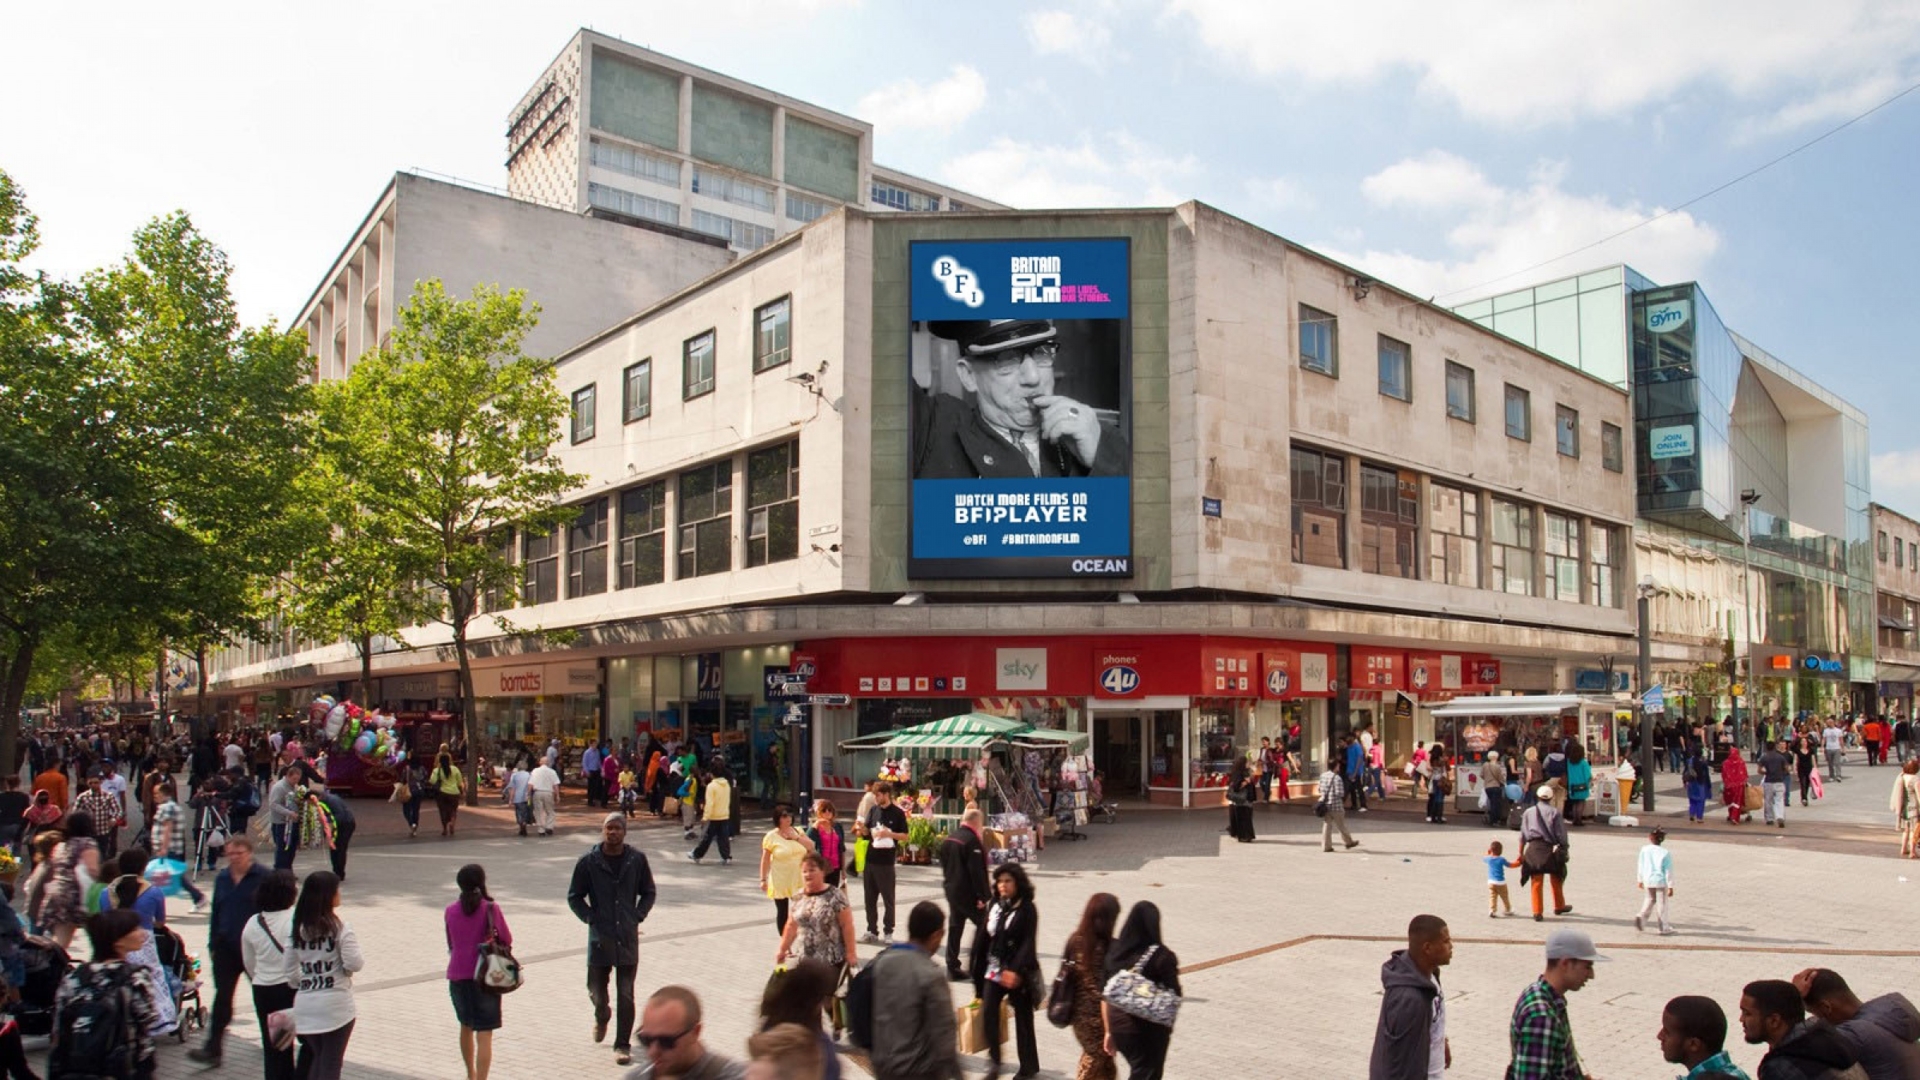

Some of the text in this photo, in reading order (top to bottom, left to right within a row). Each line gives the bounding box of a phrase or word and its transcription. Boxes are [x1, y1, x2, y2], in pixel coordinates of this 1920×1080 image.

[1011, 256, 1061, 273] BRITAIN
[940, 262, 977, 303] BFI
[1011, 273, 1061, 287] ON
[1011, 287, 1061, 303] FILM
[1651, 310, 1682, 327] gym
[1656, 441, 1687, 449] ONLINE
[1663, 434, 1682, 442] JOIN
[955, 493, 1087, 506] WATCH MORE FILMS ON
[963, 535, 987, 545] @BFI
[1072, 559, 1127, 573] OCEAN
[1103, 654, 1137, 666] phones
[1003, 658, 1039, 680] sky
[1305, 662, 1324, 682] sky
[1104, 668, 1136, 692] 4u
